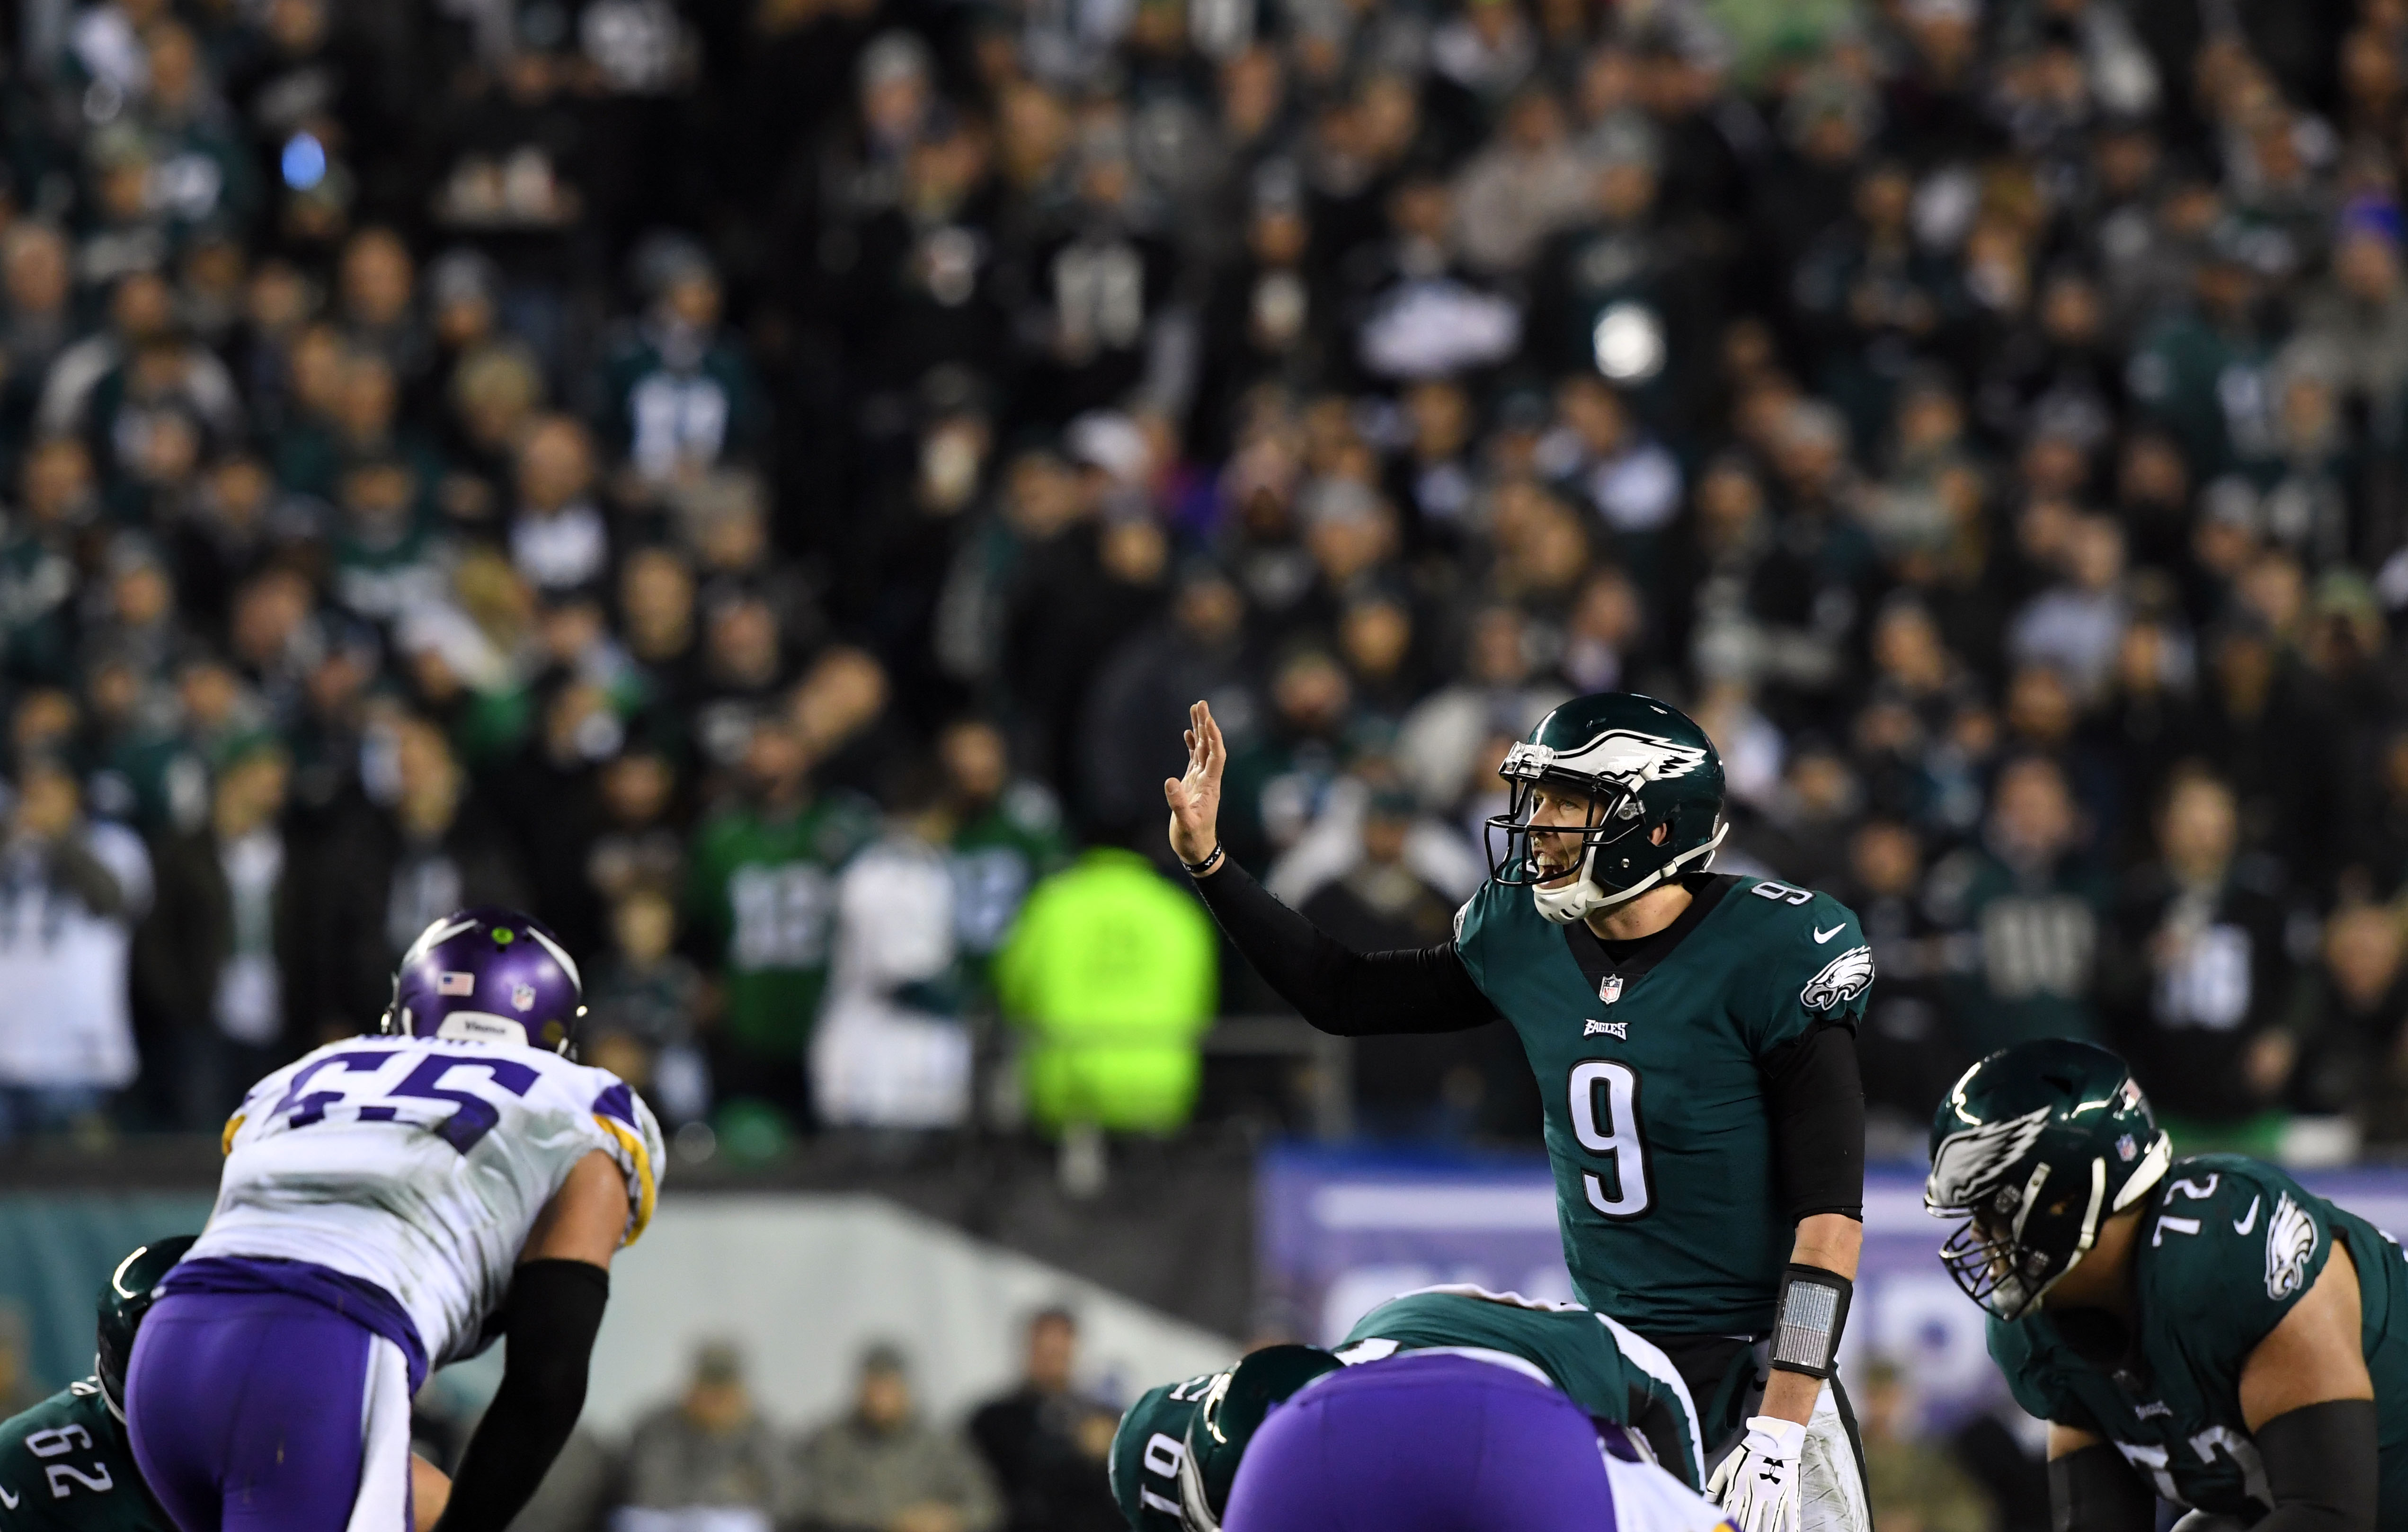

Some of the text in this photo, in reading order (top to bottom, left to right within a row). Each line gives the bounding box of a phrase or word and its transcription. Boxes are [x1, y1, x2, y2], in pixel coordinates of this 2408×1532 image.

[1751, 881, 1815, 906] 9
[1583, 1019, 1628, 1041] EAGLES
[1569, 1060, 1654, 1219] 9
[2152, 1173, 2218, 1247] 72
[25, 1424, 113, 1498] 62
